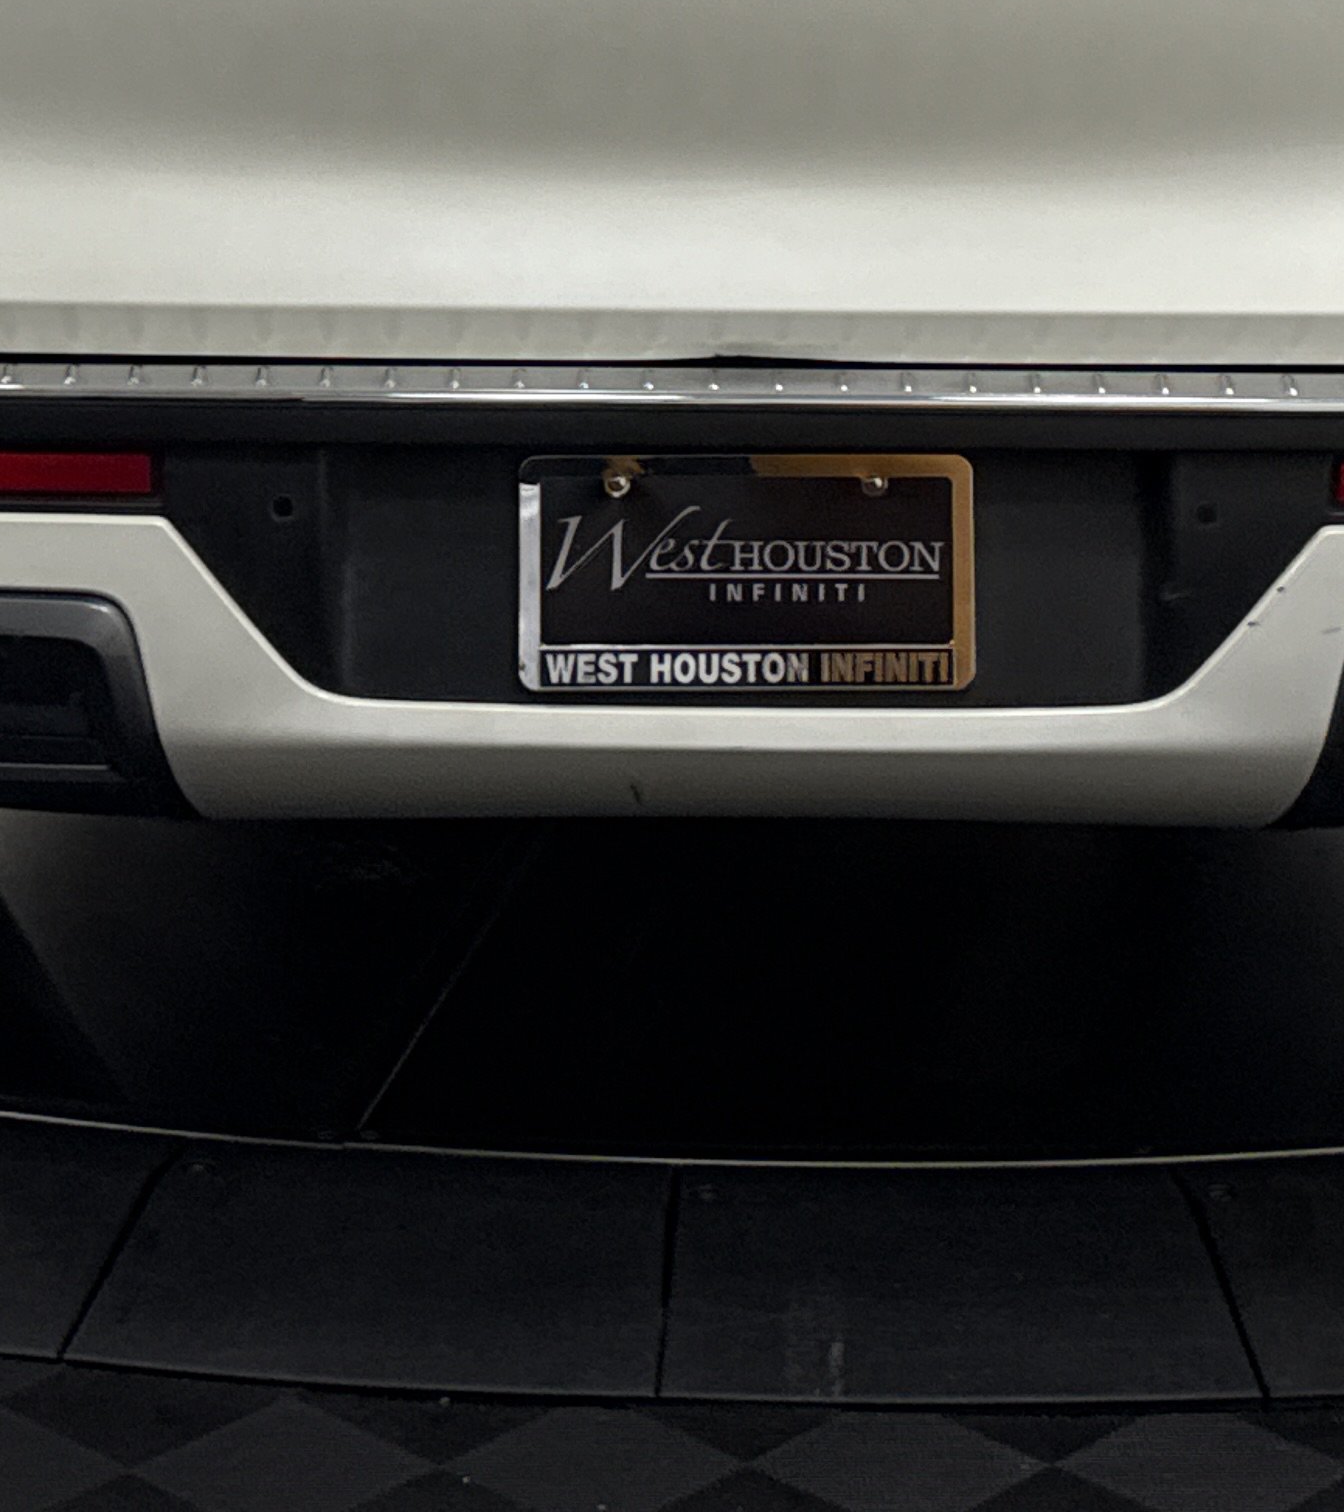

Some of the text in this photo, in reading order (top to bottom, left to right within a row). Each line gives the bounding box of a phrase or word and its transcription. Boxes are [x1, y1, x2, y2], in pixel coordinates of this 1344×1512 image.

[709, 583, 865, 602] INFINITI
[546, 653, 951, 684] WEST HOUSTON INFINITI
